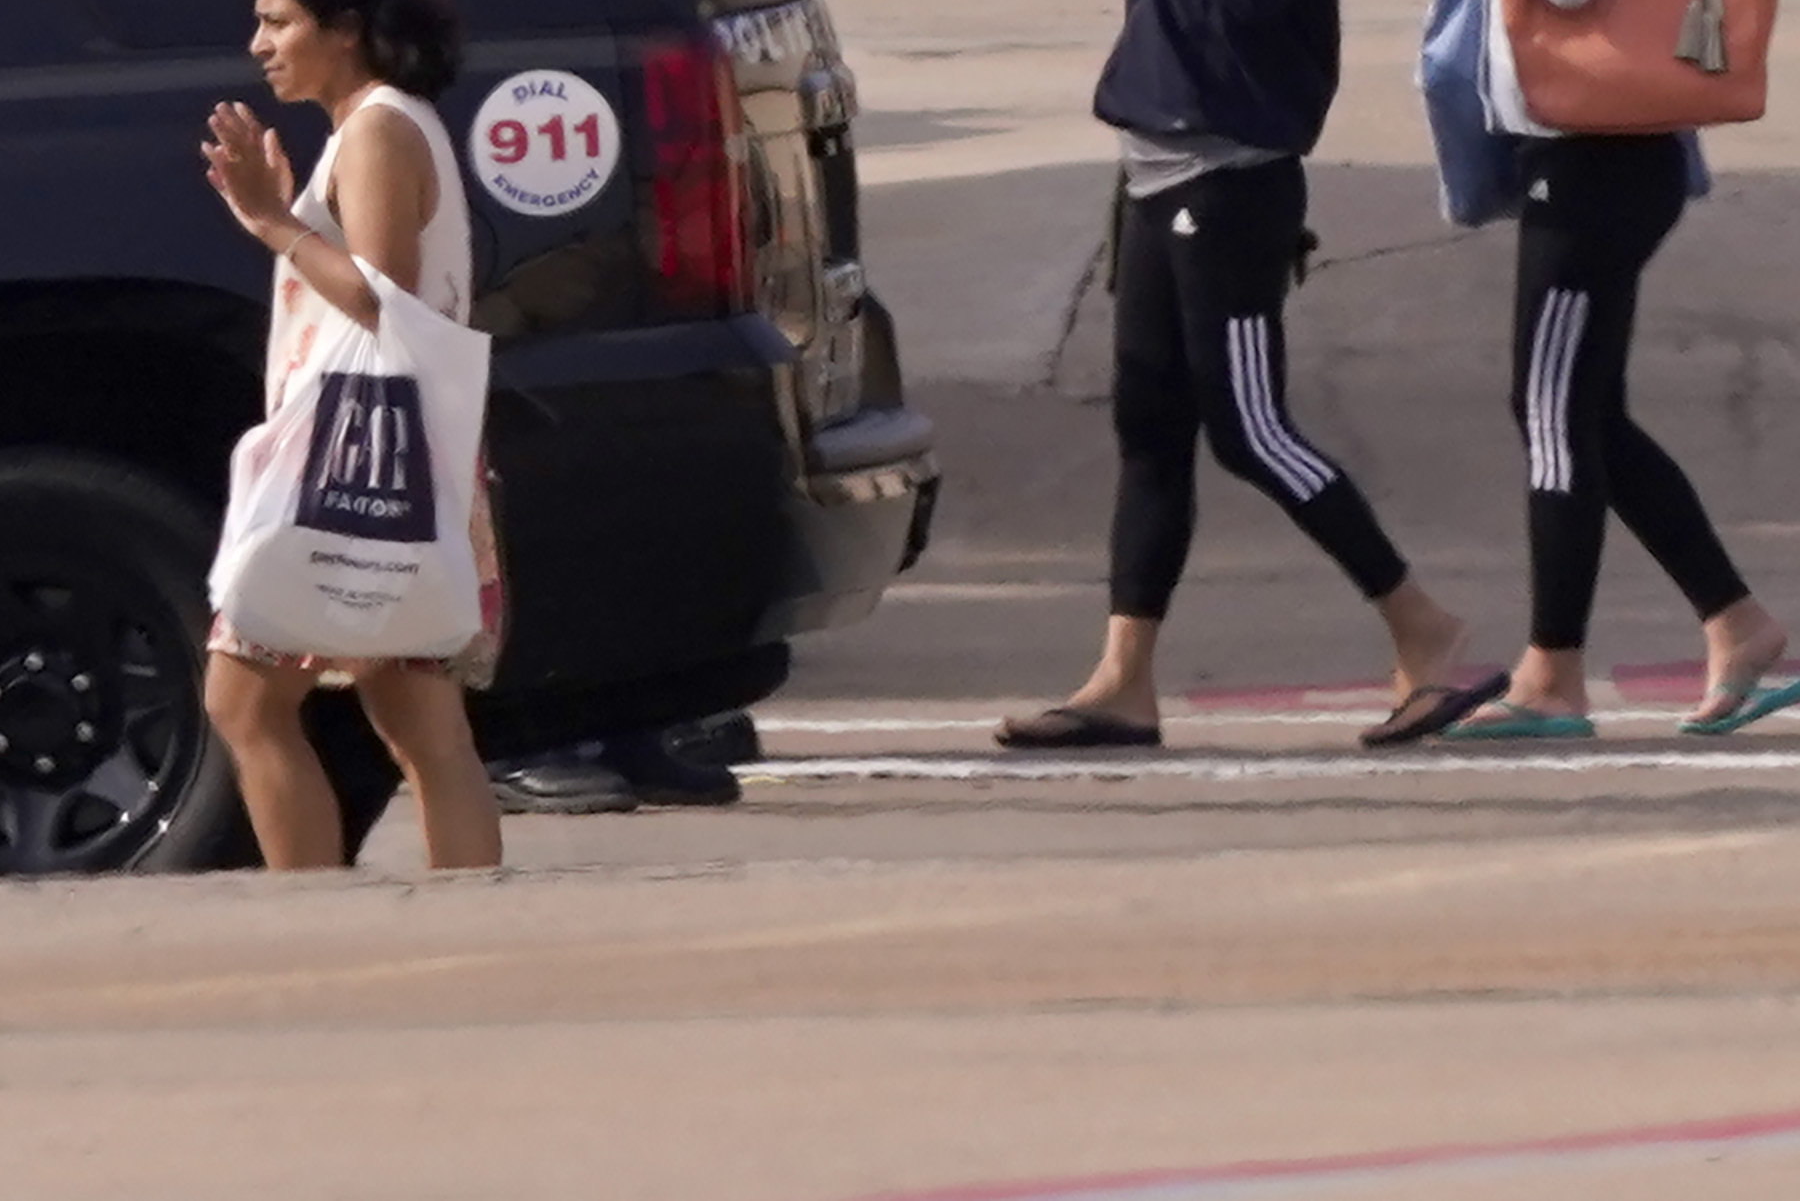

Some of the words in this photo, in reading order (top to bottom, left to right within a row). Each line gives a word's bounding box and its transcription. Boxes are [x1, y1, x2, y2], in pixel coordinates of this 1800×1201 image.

[512, 79, 569, 105] DIAL
[488, 113, 601, 165] 911
[492, 168, 601, 208] EMERGENCY
